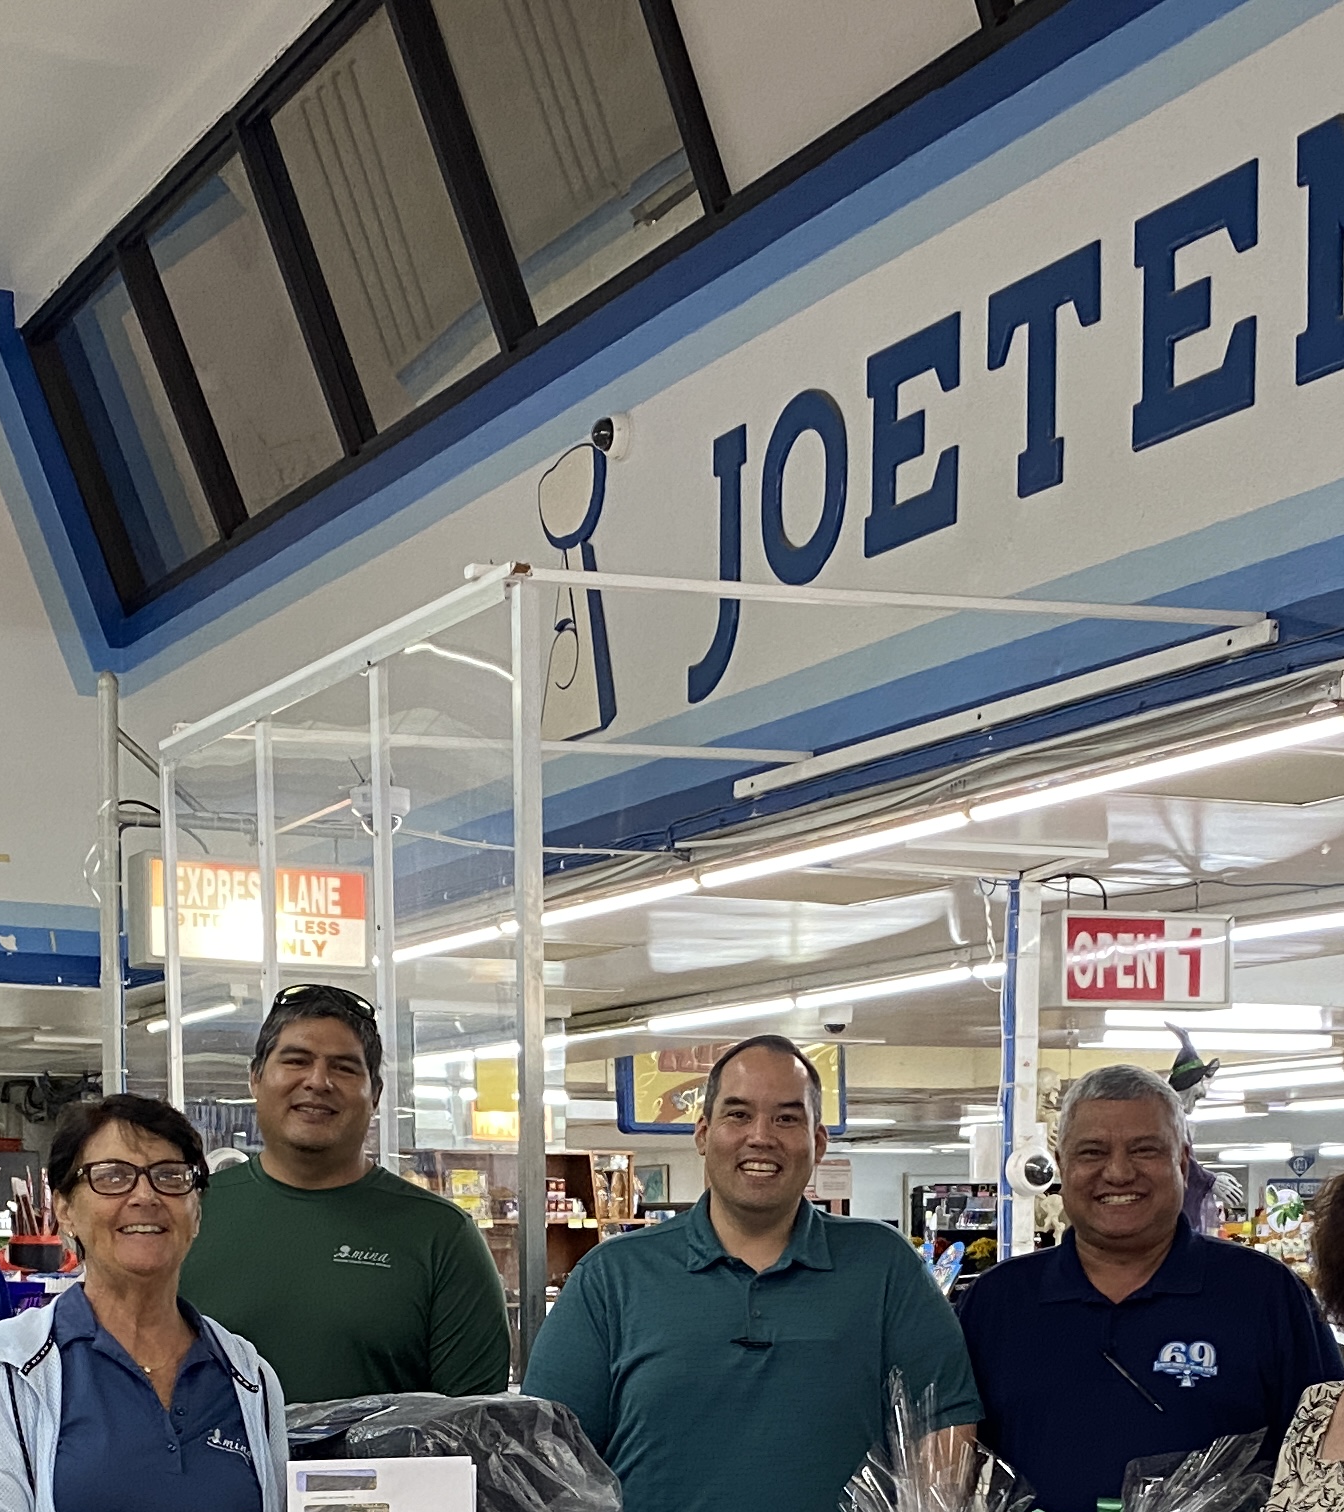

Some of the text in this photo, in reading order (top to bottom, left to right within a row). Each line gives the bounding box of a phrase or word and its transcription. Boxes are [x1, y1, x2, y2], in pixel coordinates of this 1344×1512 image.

[282, 874, 342, 916] LANE
[295, 919, 340, 936] LESS
[282, 939, 327, 957] NLY
[1073, 927, 1202, 997] OPEN 1
[351, 1246, 390, 1263] mina
[1159, 1341, 1217, 1368] 69
